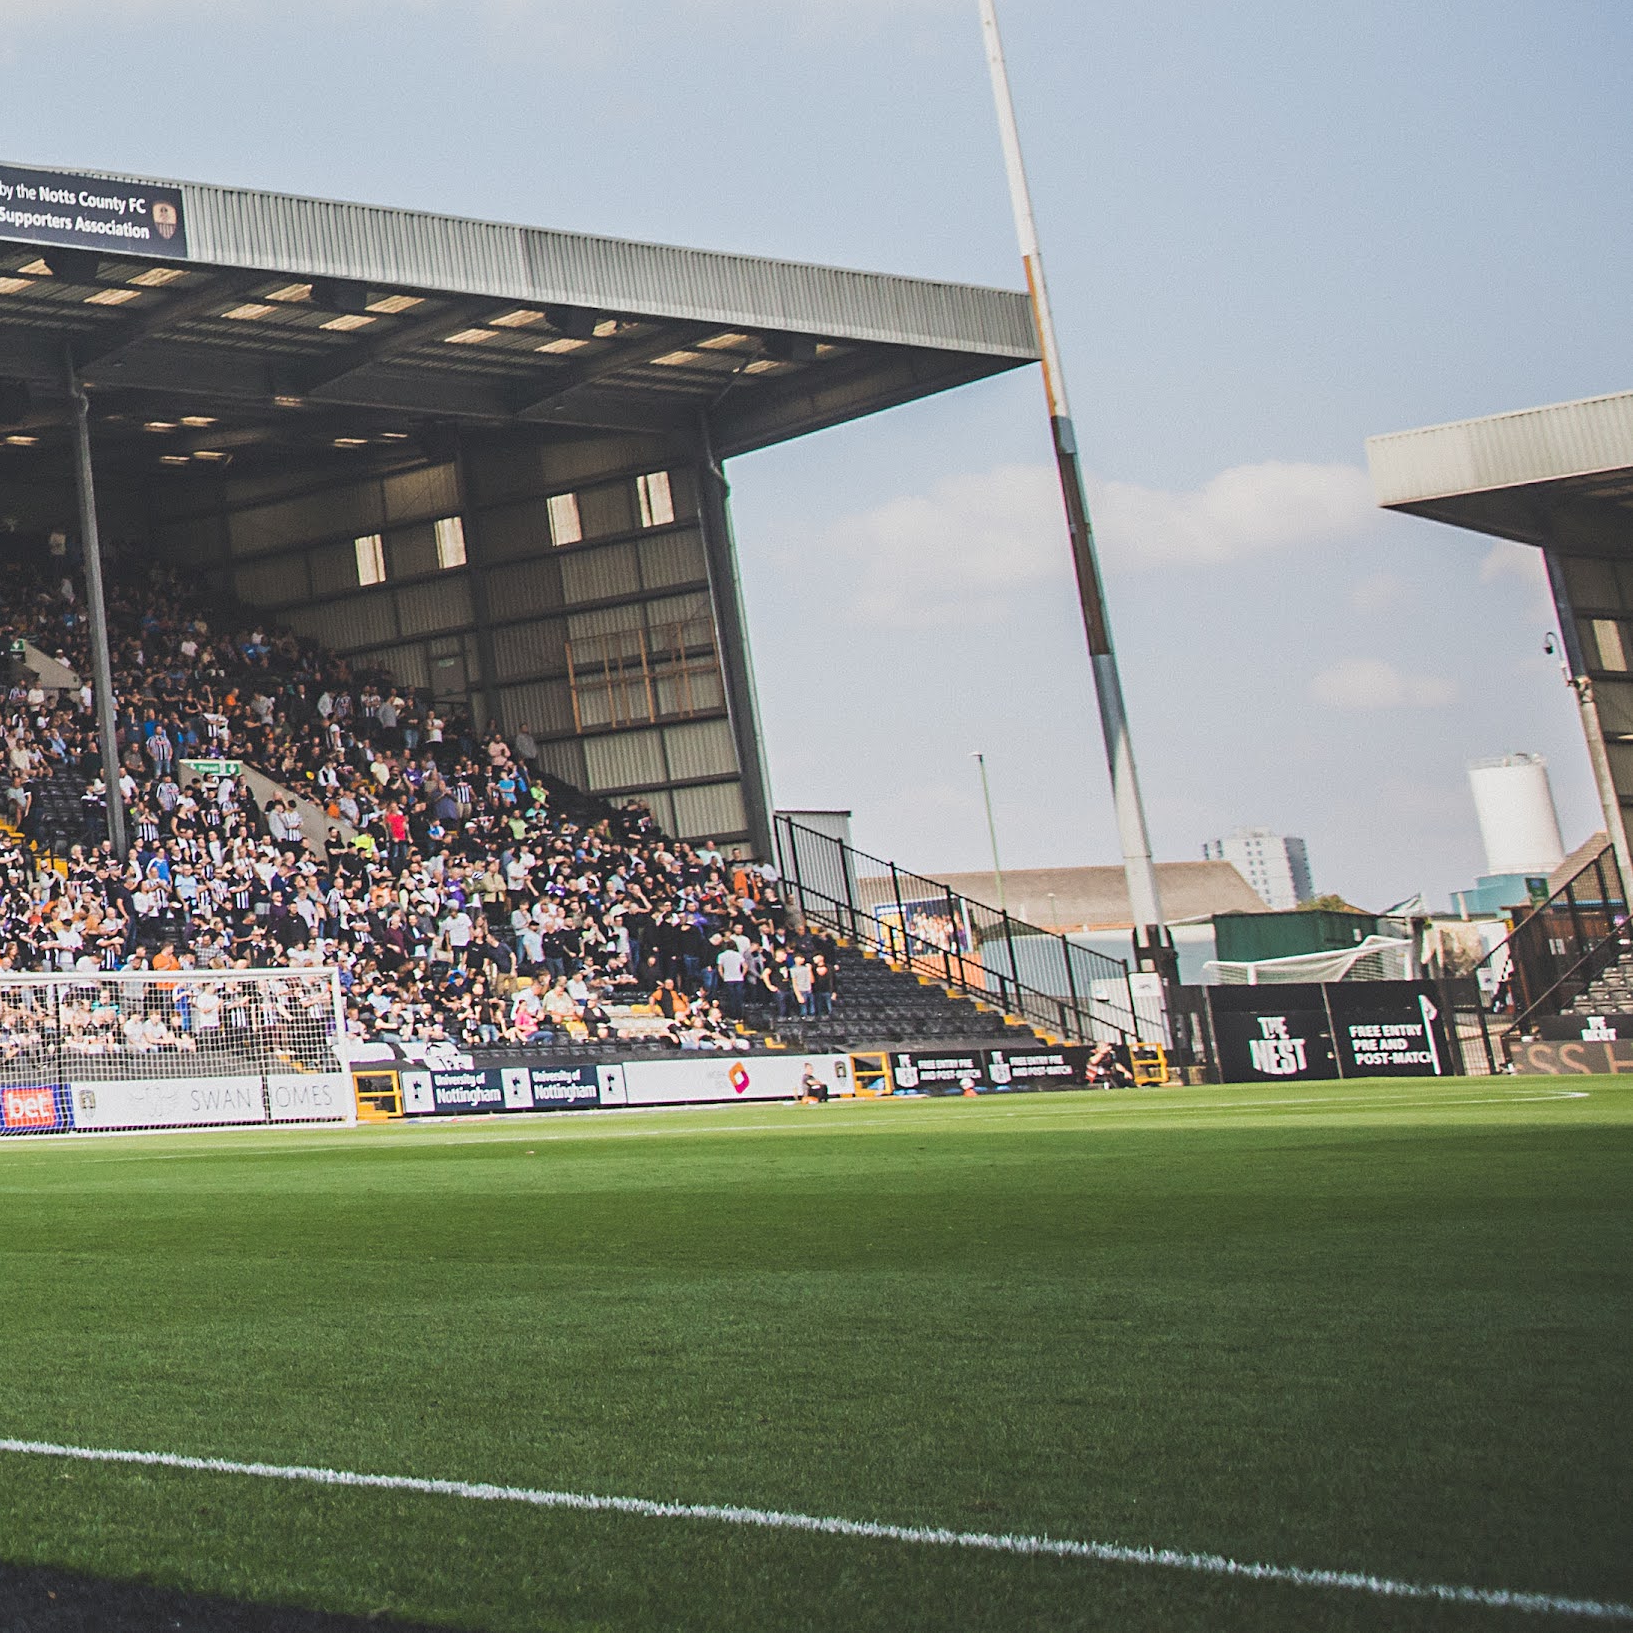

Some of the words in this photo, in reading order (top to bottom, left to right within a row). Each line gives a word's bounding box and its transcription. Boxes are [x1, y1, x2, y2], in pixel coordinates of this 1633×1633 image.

[0, 180, 14, 201] by
[16, 183, 37, 201] the
[39, 186, 77, 205] Notts
[78, 192, 127, 215] County
[129, 198, 147, 214] FC
[75, 216, 151, 240] Association
[1257, 1016, 1290, 1039] THE
[1348, 1024, 1382, 1038] FREE
[1382, 1023, 1423, 1037] ENTRY
[1351, 1039, 1378, 1051] PRE
[1379, 1038, 1408, 1051] AND
[1249, 1038, 1307, 1075] NEST
[434, 1072, 476, 1087] University
[476, 1071, 486, 1085] of
[532, 1069, 572, 1084] University
[571, 1069, 581, 1081] of
[191, 1088, 251, 1112] SWAN
[436, 1085, 502, 1106] Nottingham
[534, 1082, 597, 1103] Nottingham
[8, 1092, 50, 1119] bet
